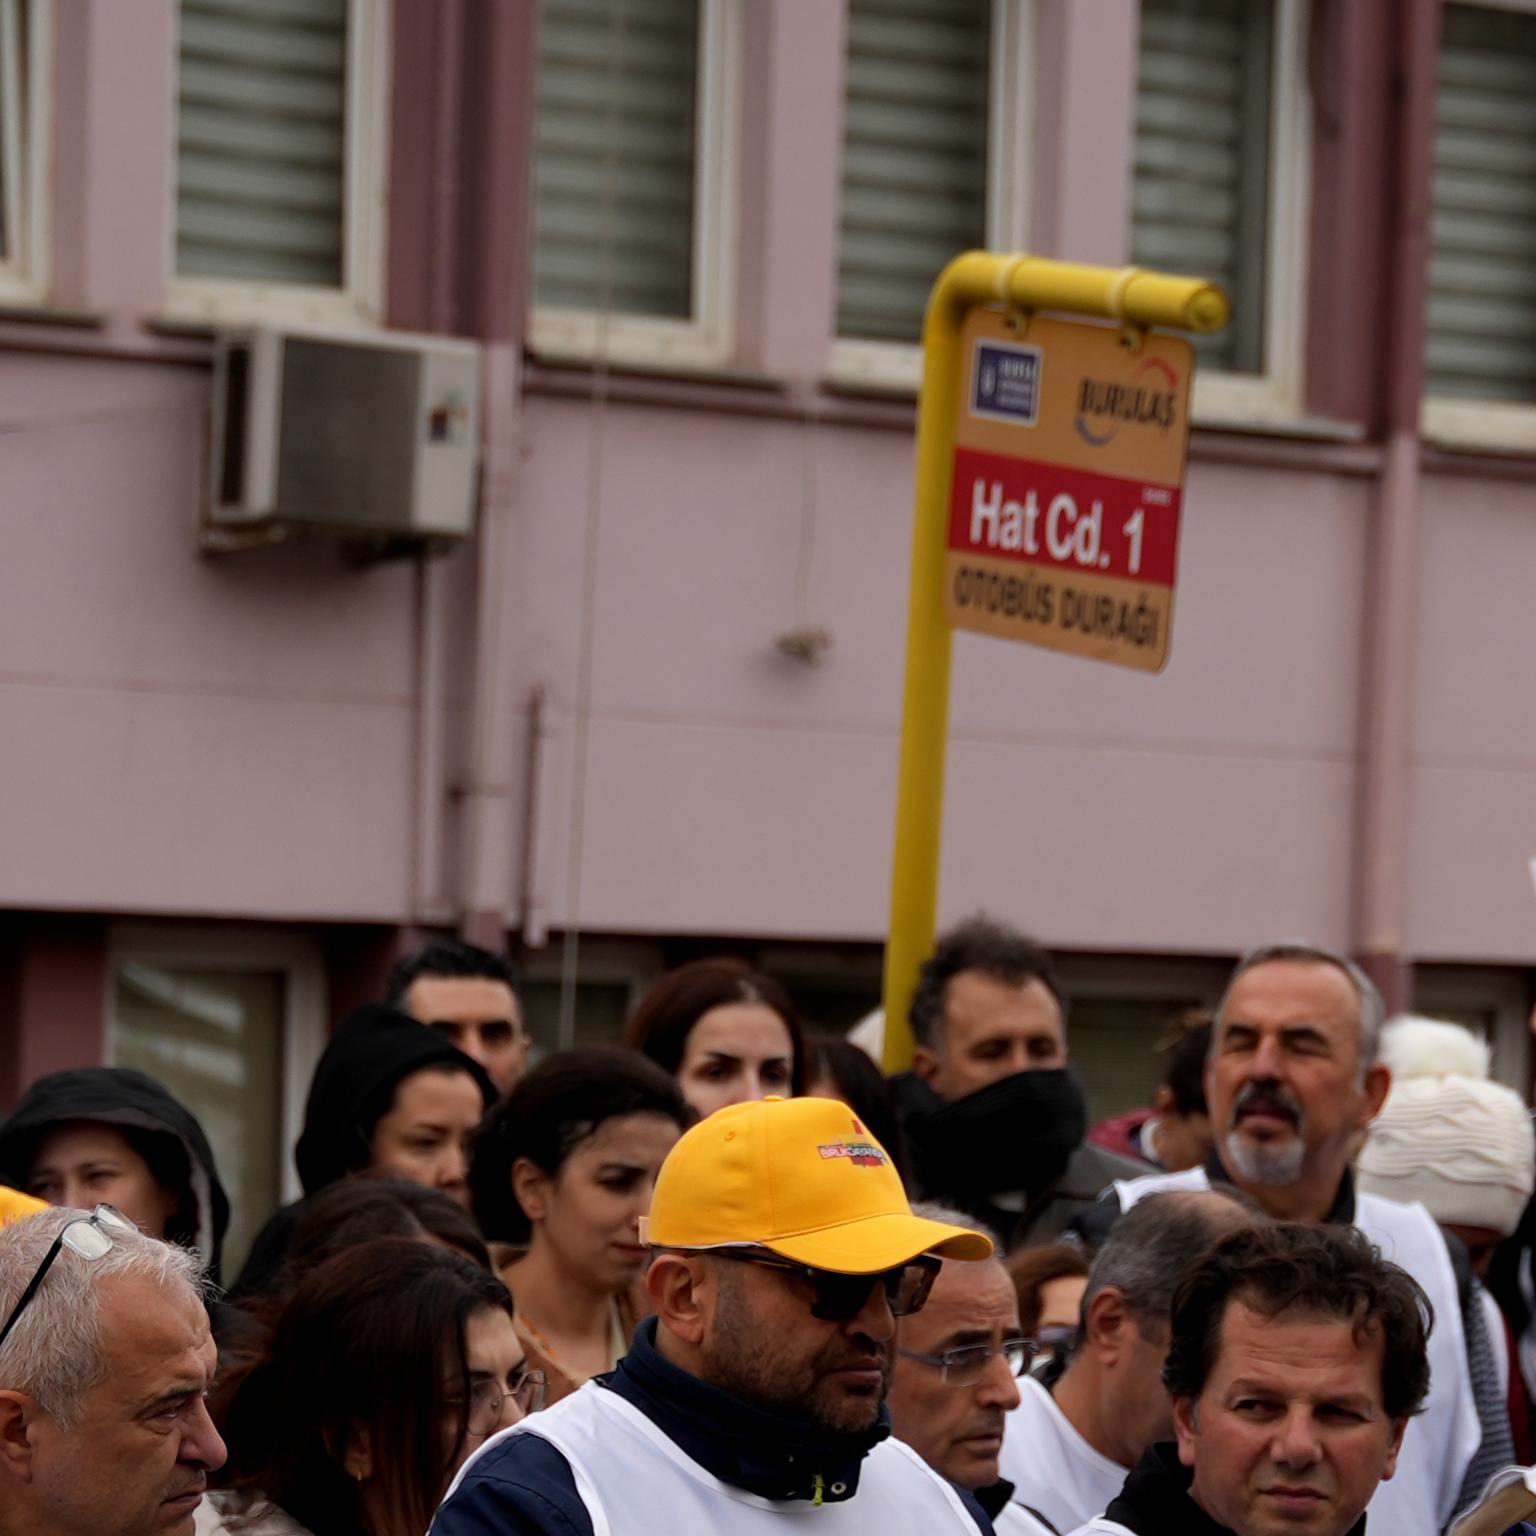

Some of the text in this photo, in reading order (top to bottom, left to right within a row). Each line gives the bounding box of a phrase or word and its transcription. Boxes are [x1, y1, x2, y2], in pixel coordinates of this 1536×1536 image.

[970, 479, 1145, 574] Hat Cd. 1
[954, 567, 1158, 649] OTOBÜS DURAĞI
